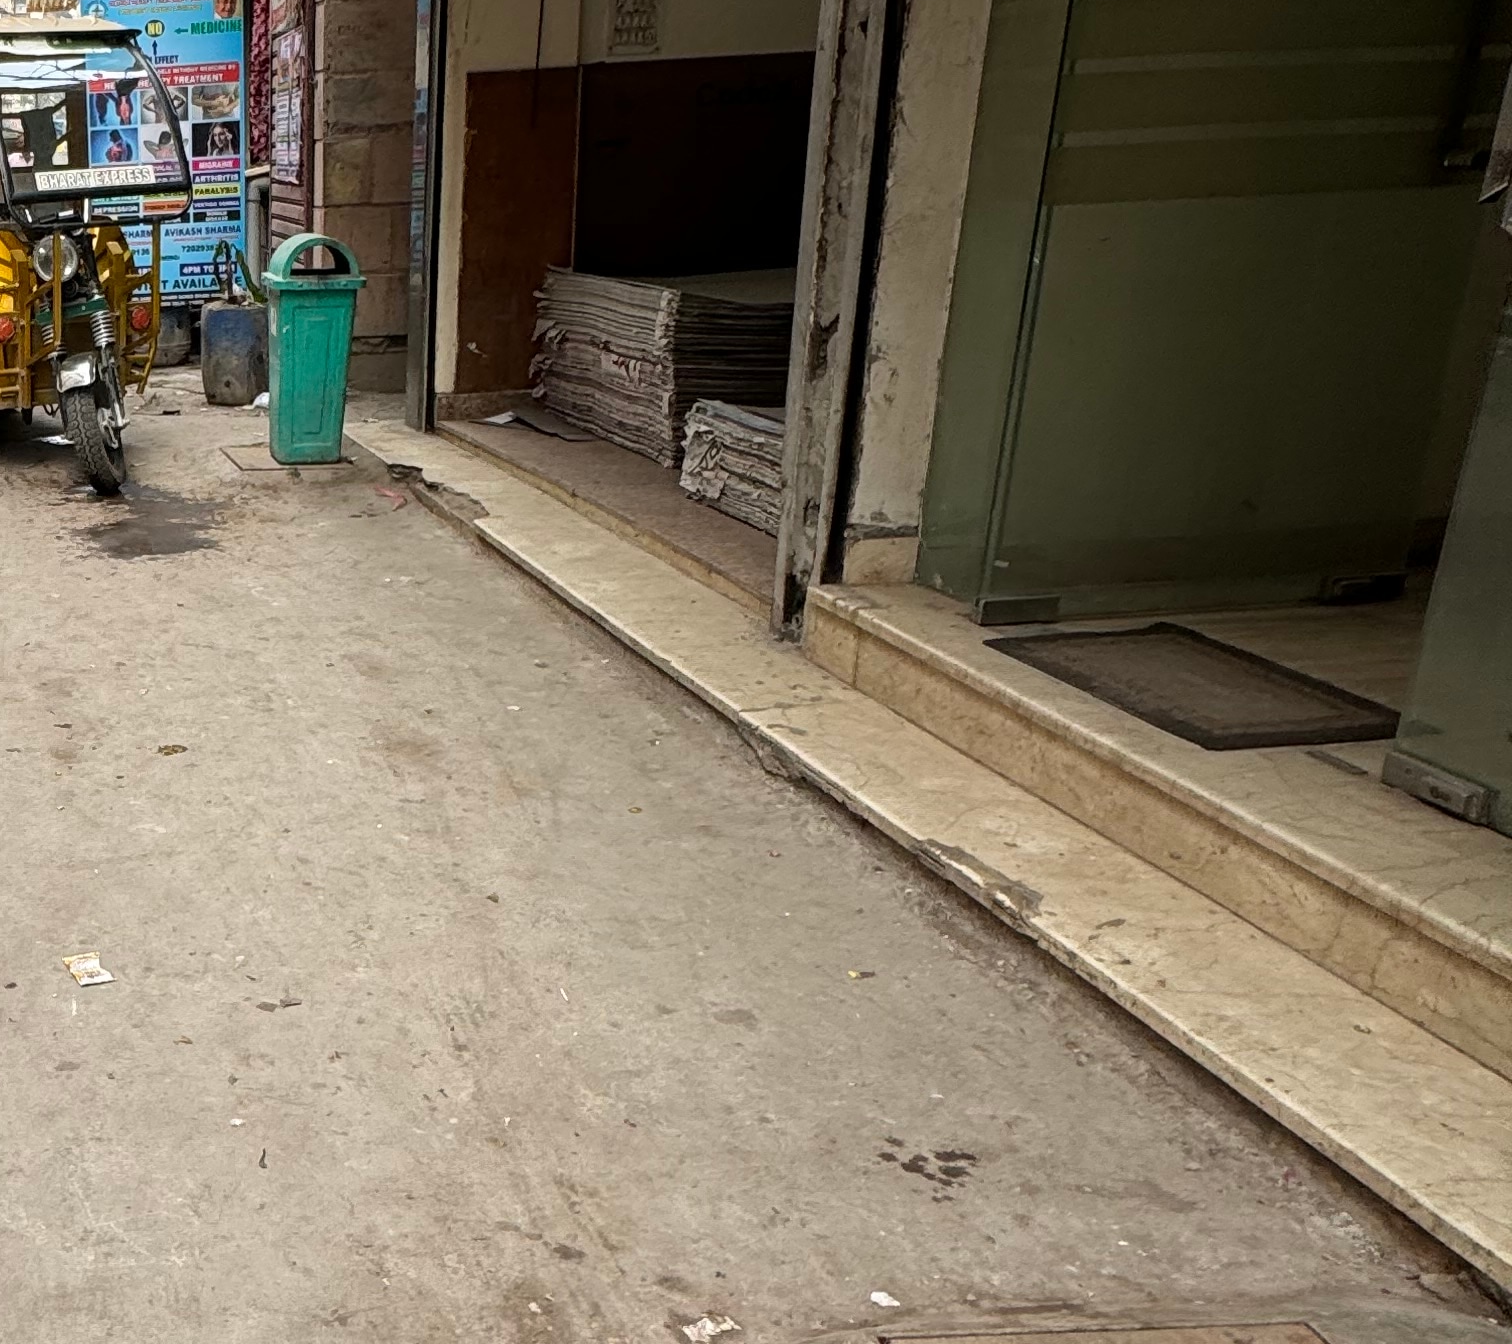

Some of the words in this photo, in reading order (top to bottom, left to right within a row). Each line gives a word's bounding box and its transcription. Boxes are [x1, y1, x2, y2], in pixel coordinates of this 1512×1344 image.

[147, 22, 163, 36] NO
[190, 19, 243, 35] MEDICINE
[155, 54, 179, 65] EFFECT
[173, 74, 224, 85] TREATMENT
[39, 171, 91, 190] BHARAT
[93, 168, 151, 186] EXPRESS
[194, 186, 239, 196] PARALYSIS
[164, 227, 203, 237] AVIKASH
[205, 225, 242, 235] SHARMA
[182, 266, 201, 274] 4PM
[172, 276, 243, 290] AVAILAE
